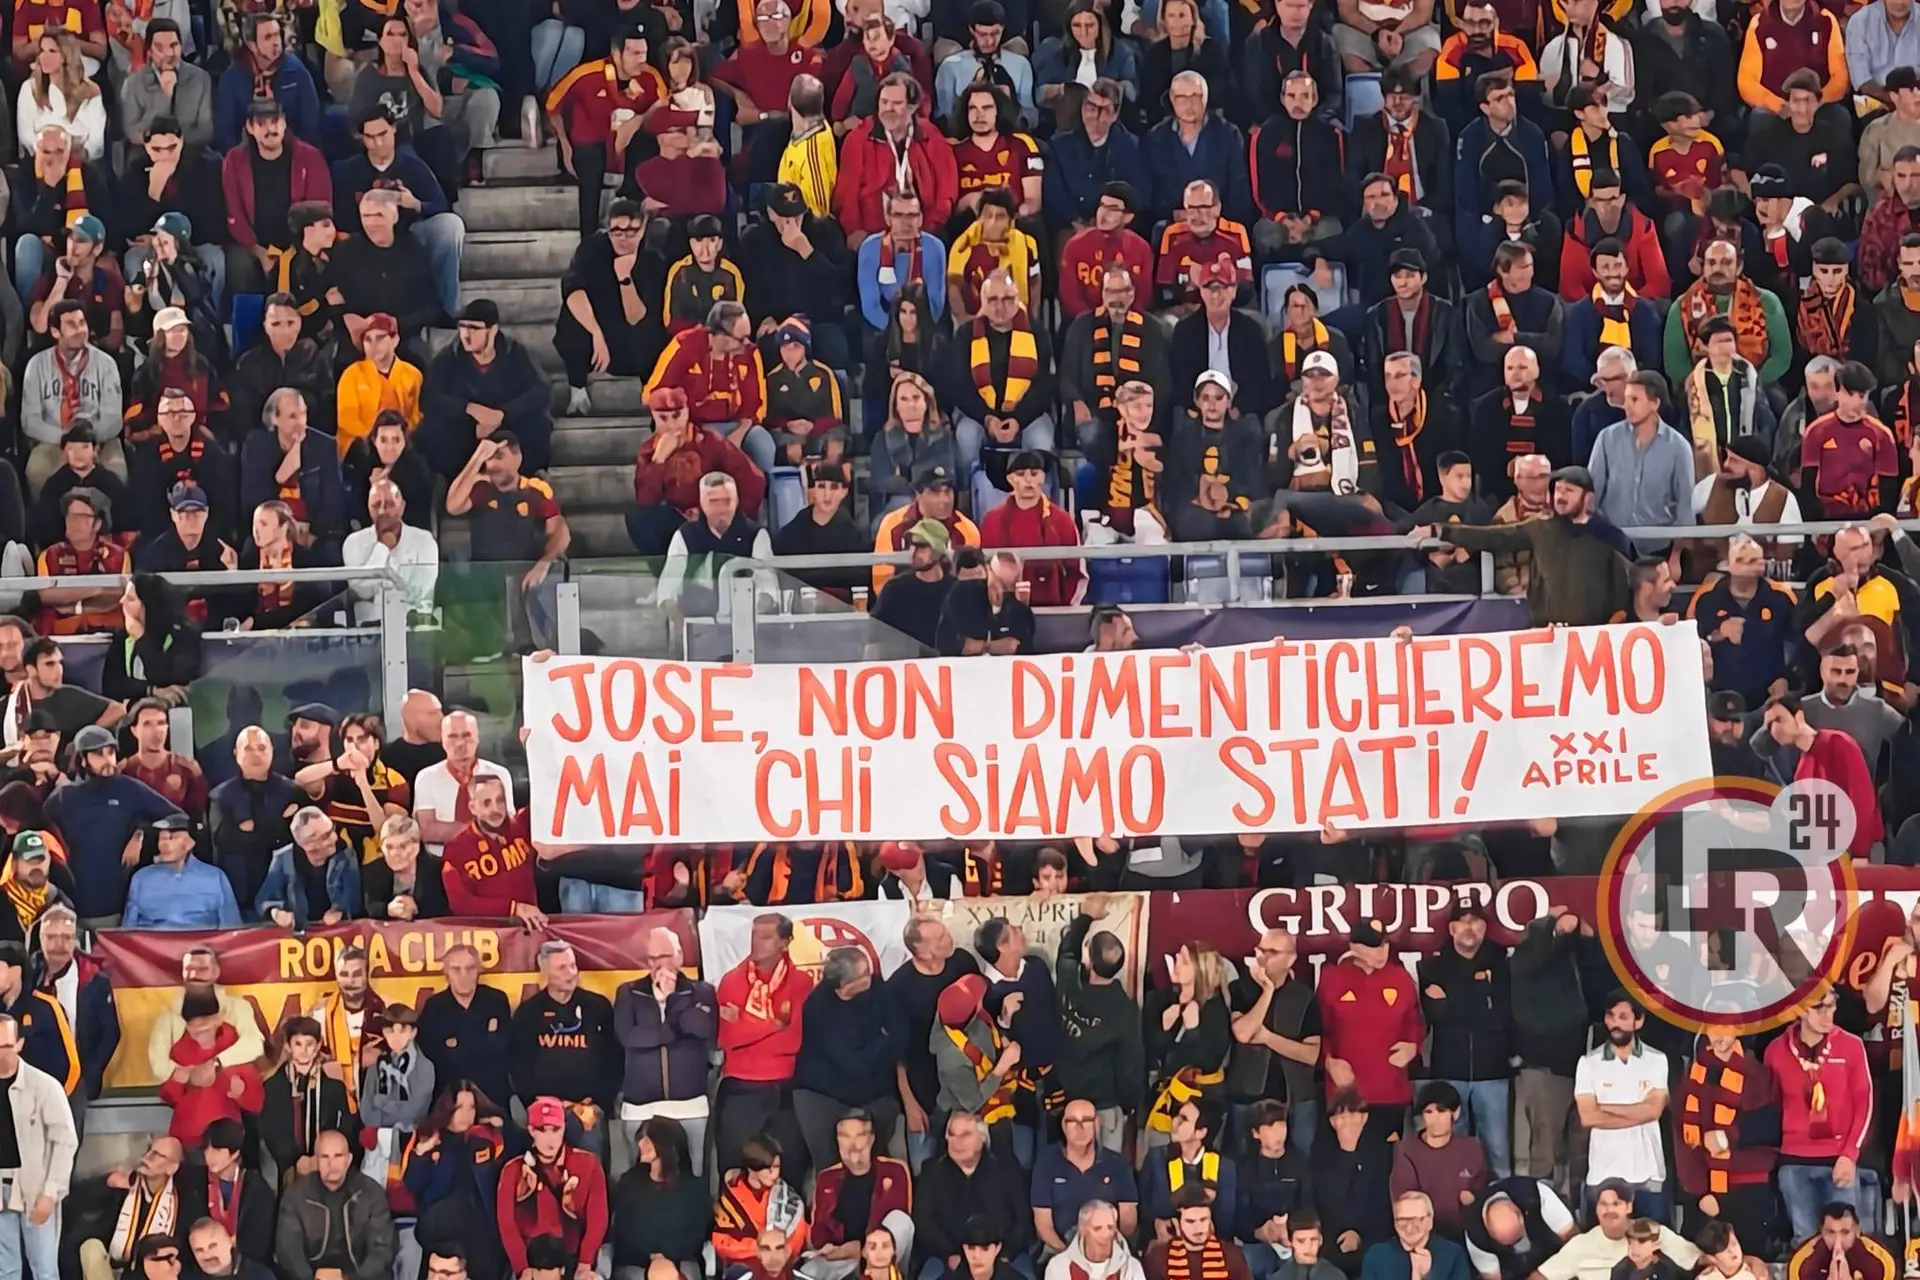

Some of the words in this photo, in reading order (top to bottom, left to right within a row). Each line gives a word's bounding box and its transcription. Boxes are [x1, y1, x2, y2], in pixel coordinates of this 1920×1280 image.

[799, 663, 954, 740] NON
[1550, 727, 1628, 758] XXI
[1522, 753, 1659, 789] APRILE
